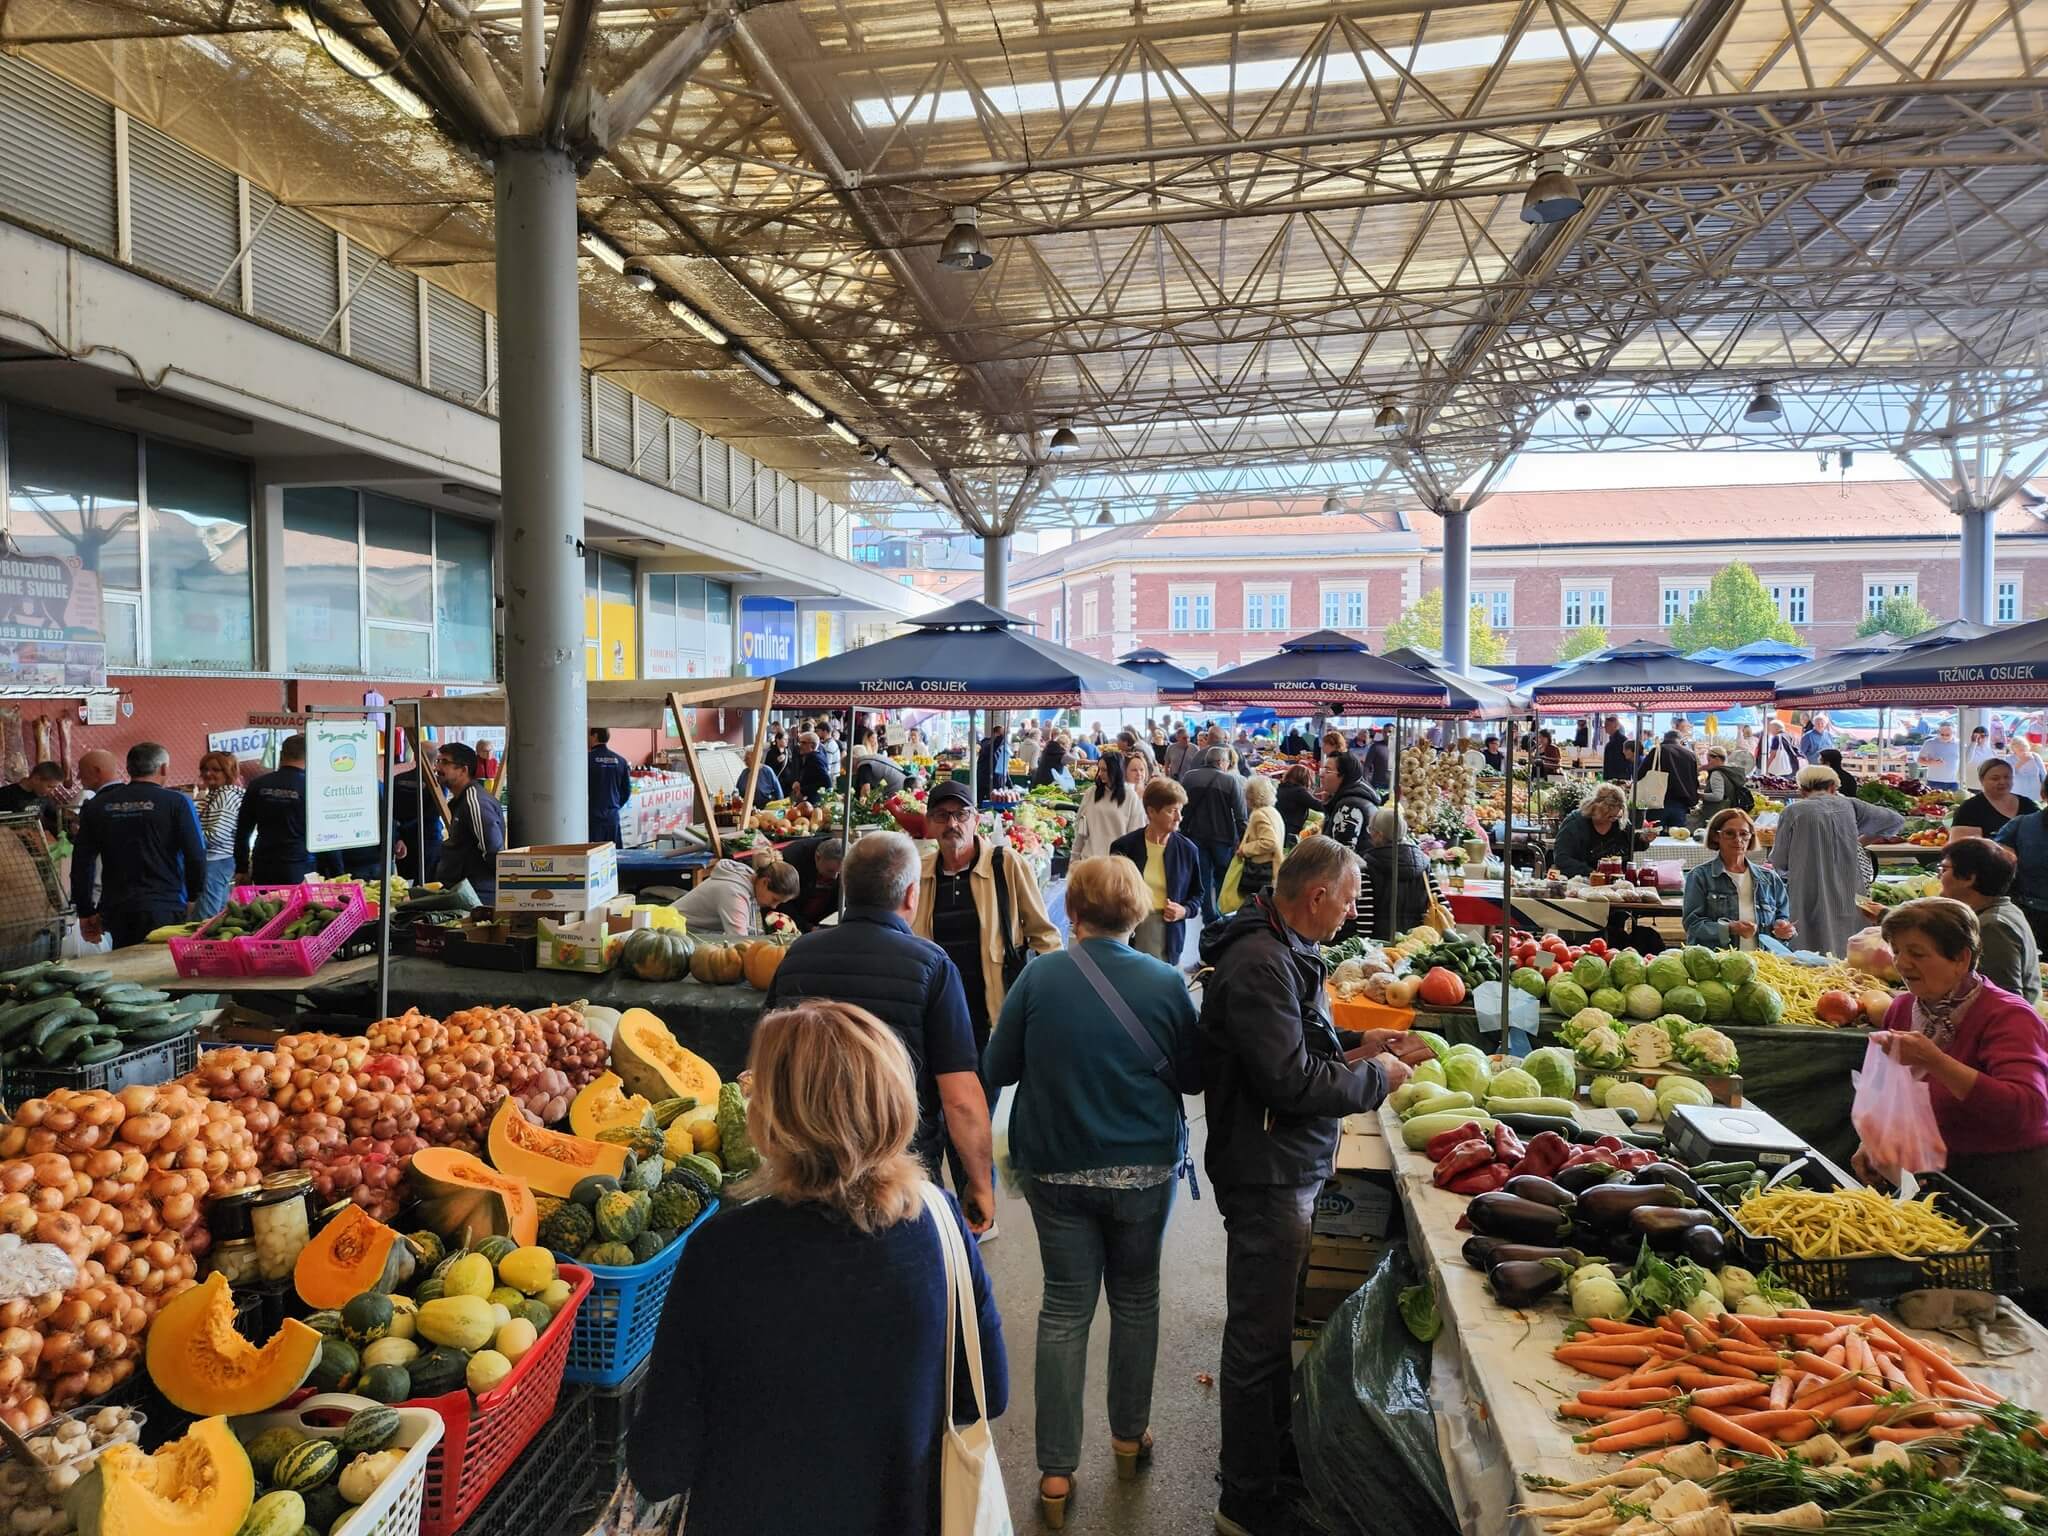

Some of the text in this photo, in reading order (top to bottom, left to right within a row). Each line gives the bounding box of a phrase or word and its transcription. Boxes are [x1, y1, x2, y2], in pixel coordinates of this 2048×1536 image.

[0, 559, 62, 581] ROIZVODI
[26, 581, 69, 599] SVINJE
[753, 626, 791, 662] mlinar
[1937, 665, 2035, 682] TRŽNICA OSIJEK
[859, 679, 968, 692] TRŽNICA OSIJEK
[1273, 681, 1358, 692] TRŽNICA OSIJEK
[1612, 685, 1694, 693] TRŽNICA OSIJEK
[323, 784, 364, 798] Certifikat
[641, 788, 692, 808] LAMPIONI
